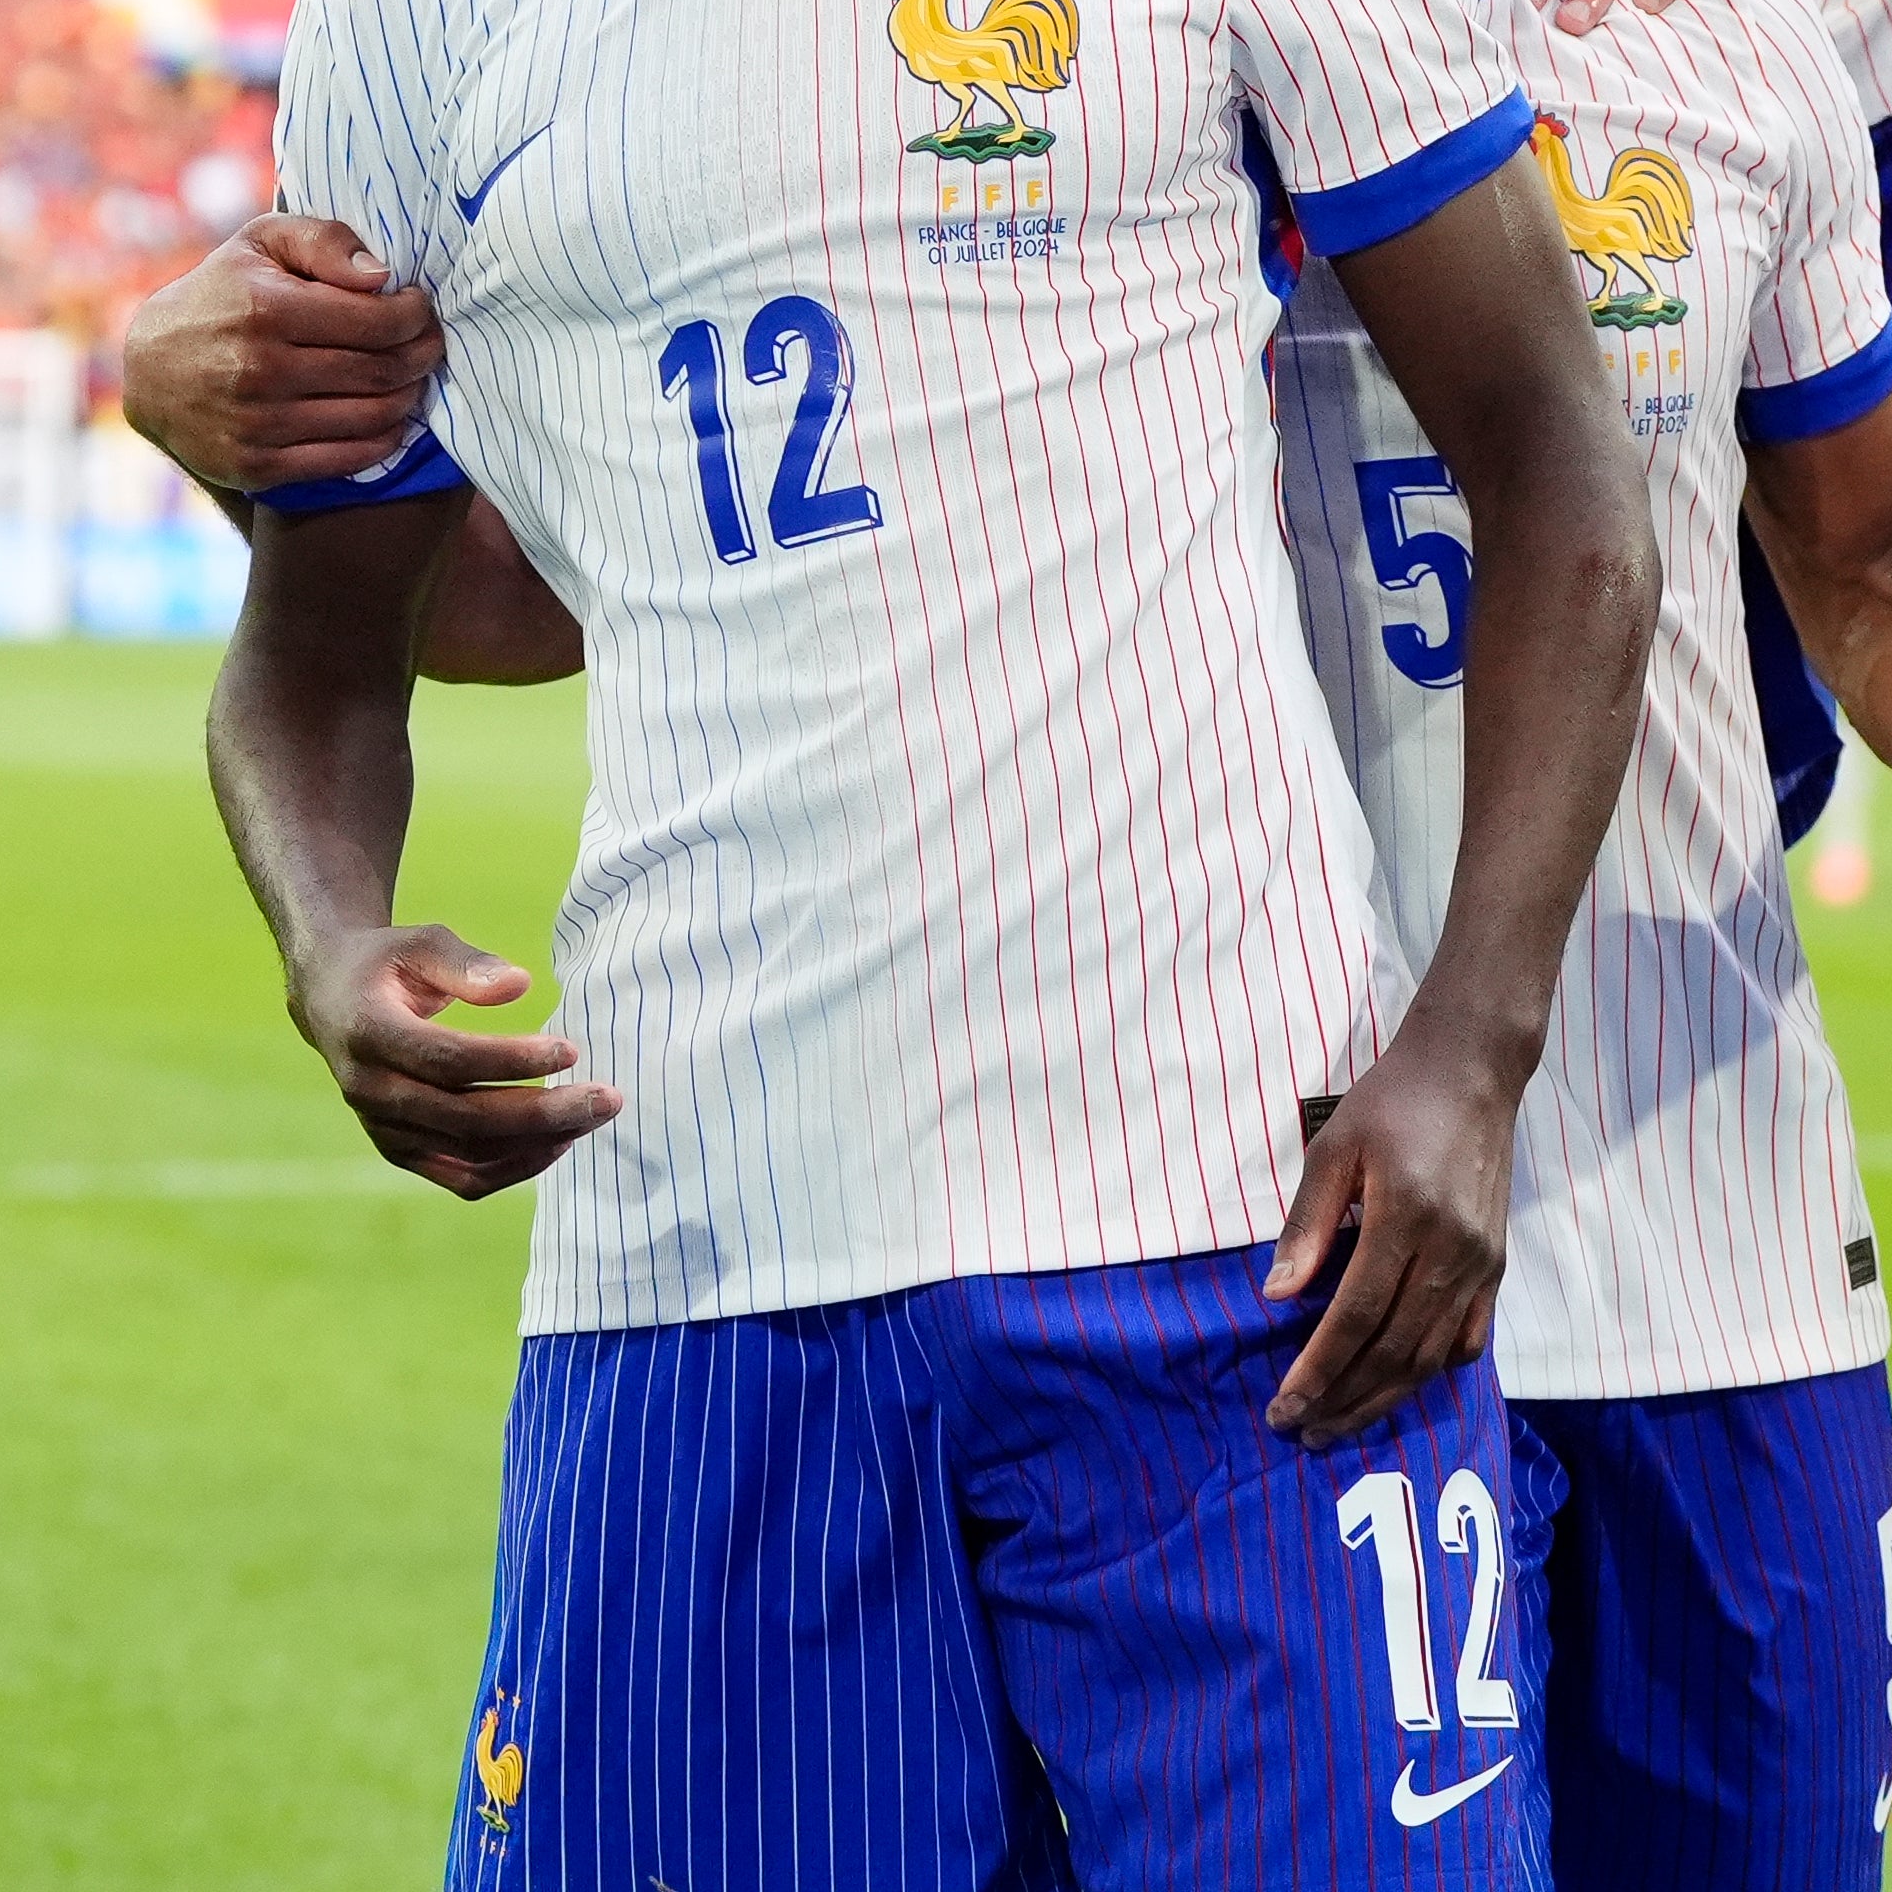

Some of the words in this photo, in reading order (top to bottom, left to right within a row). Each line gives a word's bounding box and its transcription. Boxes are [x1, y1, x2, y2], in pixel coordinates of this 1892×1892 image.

[918, 223, 977, 245] FRANCE
[996, 218, 1067, 239] BELGIQUE
[928, 246, 948, 265] 01
[954, 242, 1005, 263] JUILLET
[1013, 238, 1060, 259] 2024
[658, 295, 884, 565] 12
[1353, 455, 1472, 690] 5
[1336, 1468, 1520, 1732] 12
